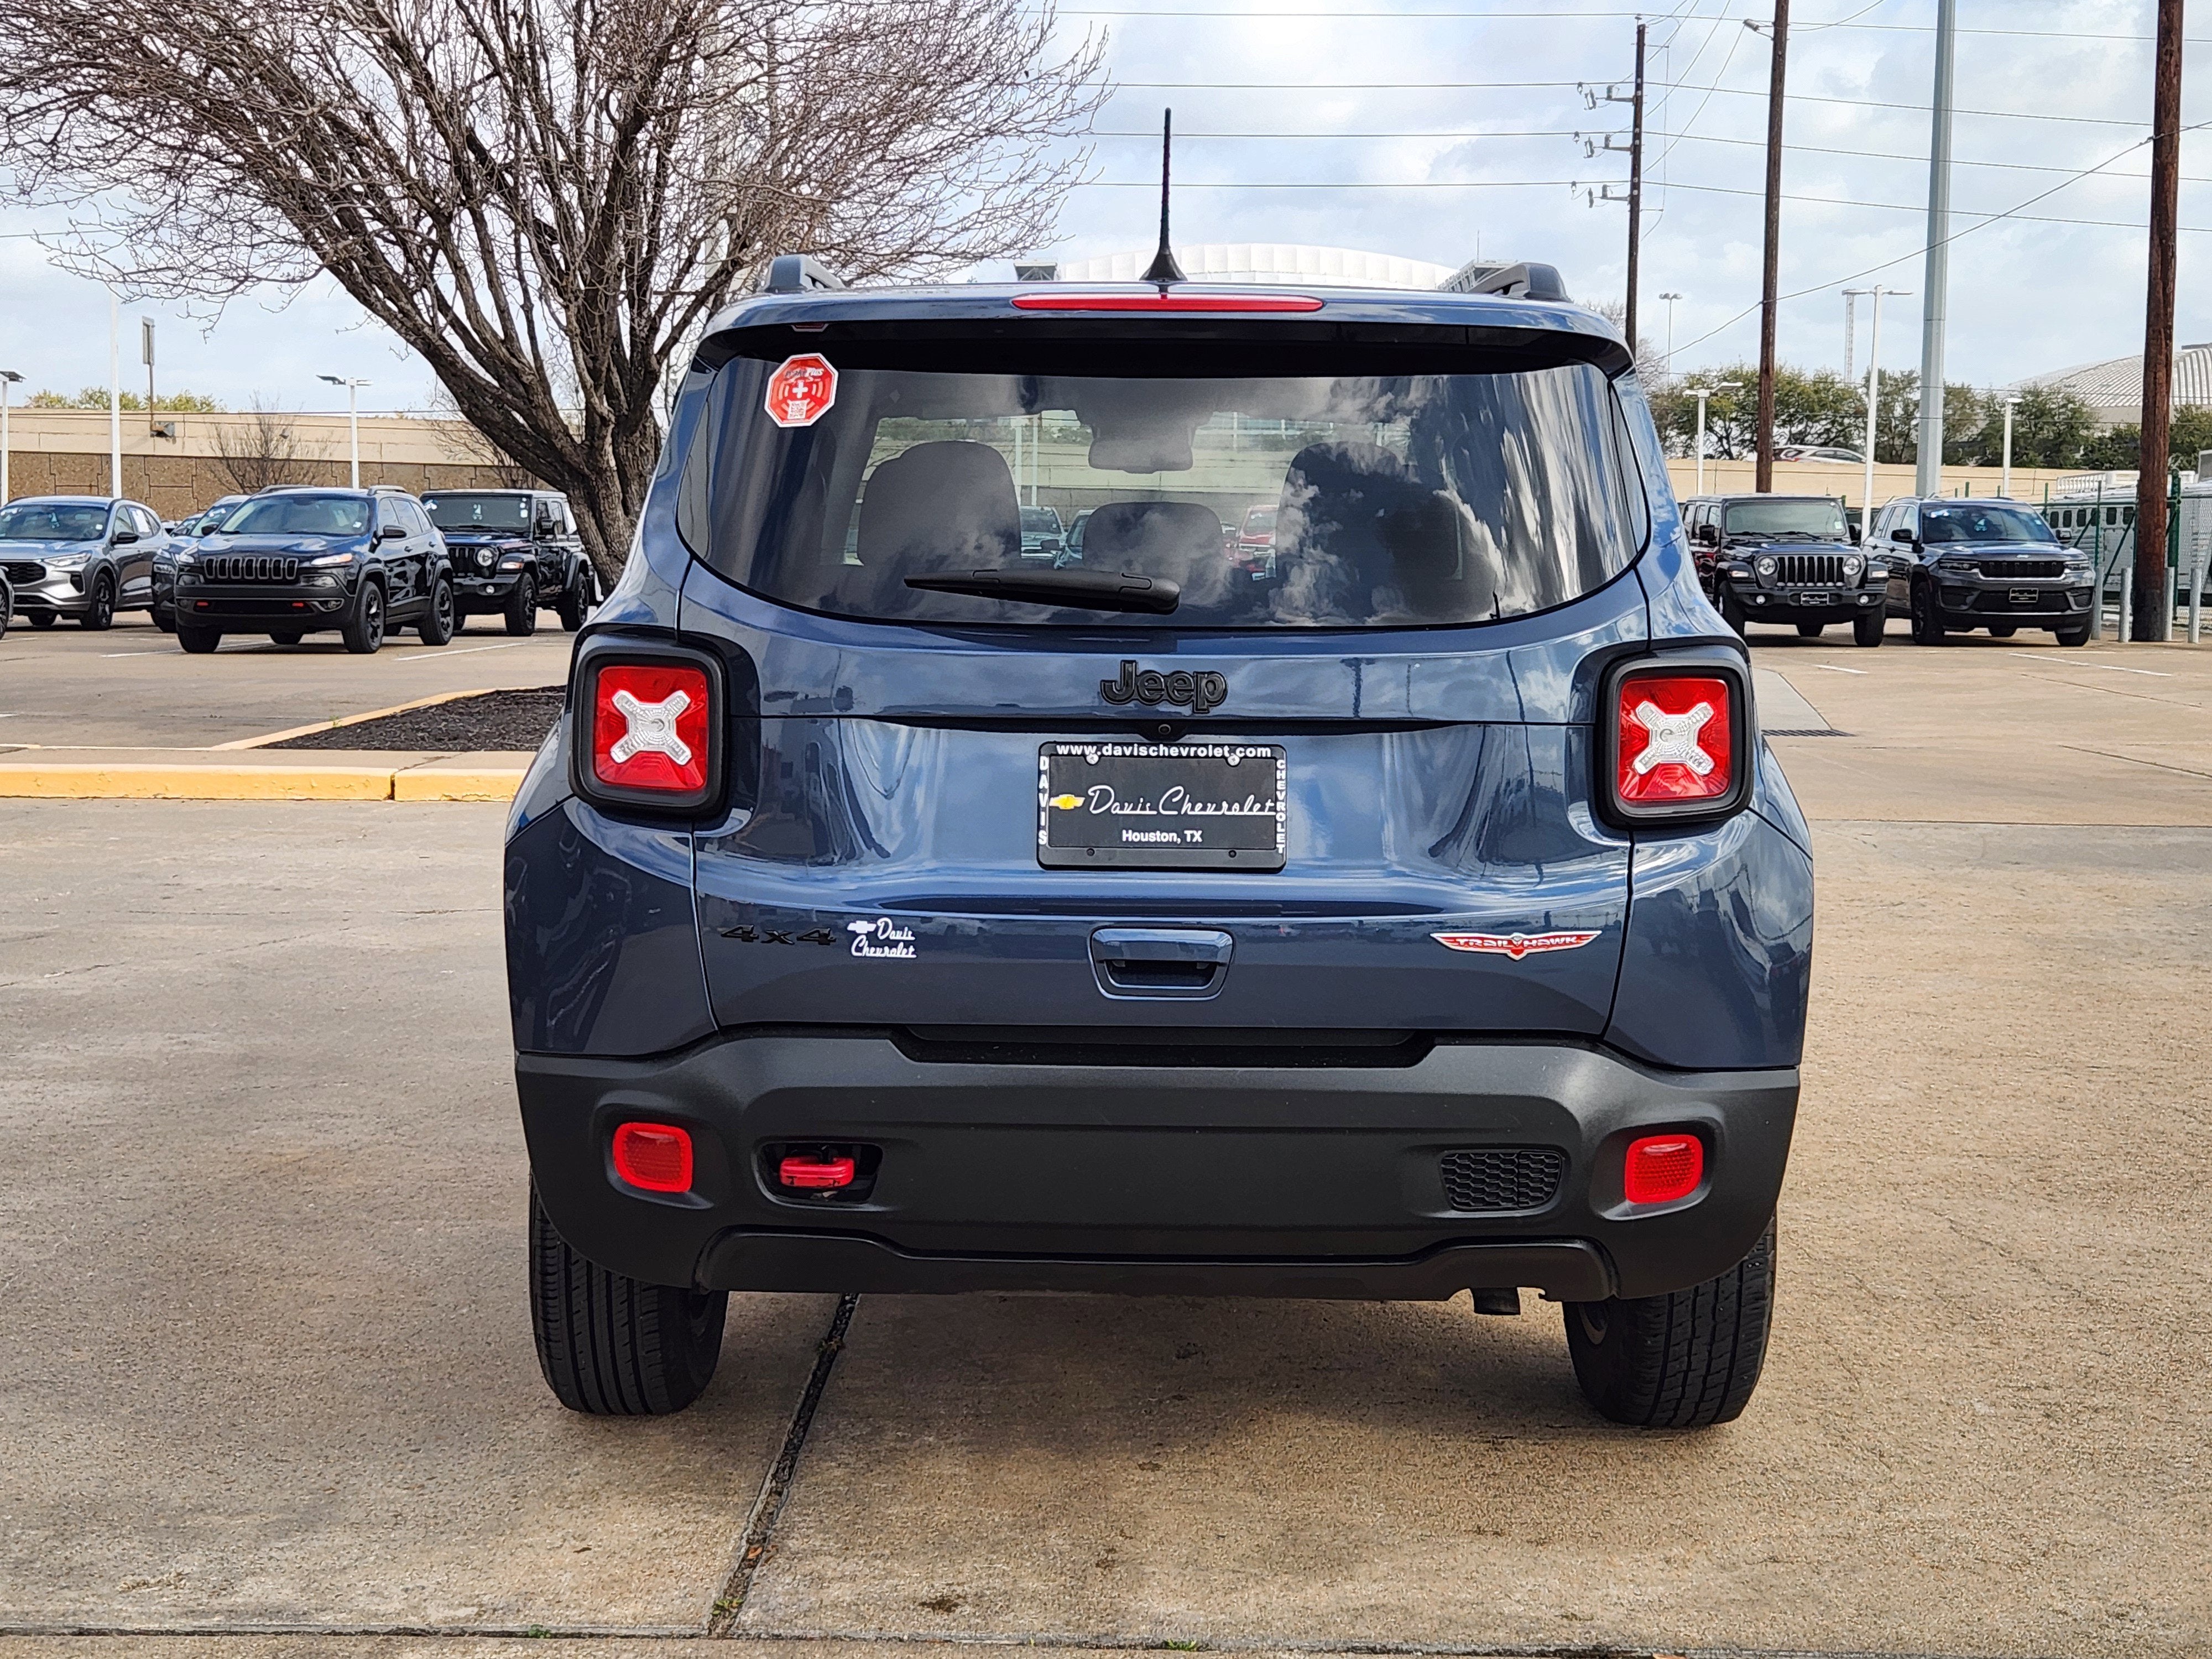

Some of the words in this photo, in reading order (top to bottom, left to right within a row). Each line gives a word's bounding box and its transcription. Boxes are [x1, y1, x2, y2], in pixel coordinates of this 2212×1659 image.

[1100, 660, 1228, 714] Jeep
[1056, 743, 1271, 758] www.davischevrolet.com
[1039, 756, 1049, 845] DAVIS
[1087, 785, 1157, 815] Davis
[1159, 786, 1276, 815] Chevrolet
[1276, 759, 1286, 854] CHEVROLET
[1121, 830, 1181, 844] Houston,
[1183, 830, 1203, 842] TX
[877, 917, 916, 941] Davis
[851, 935, 917, 958] Chevrolet
